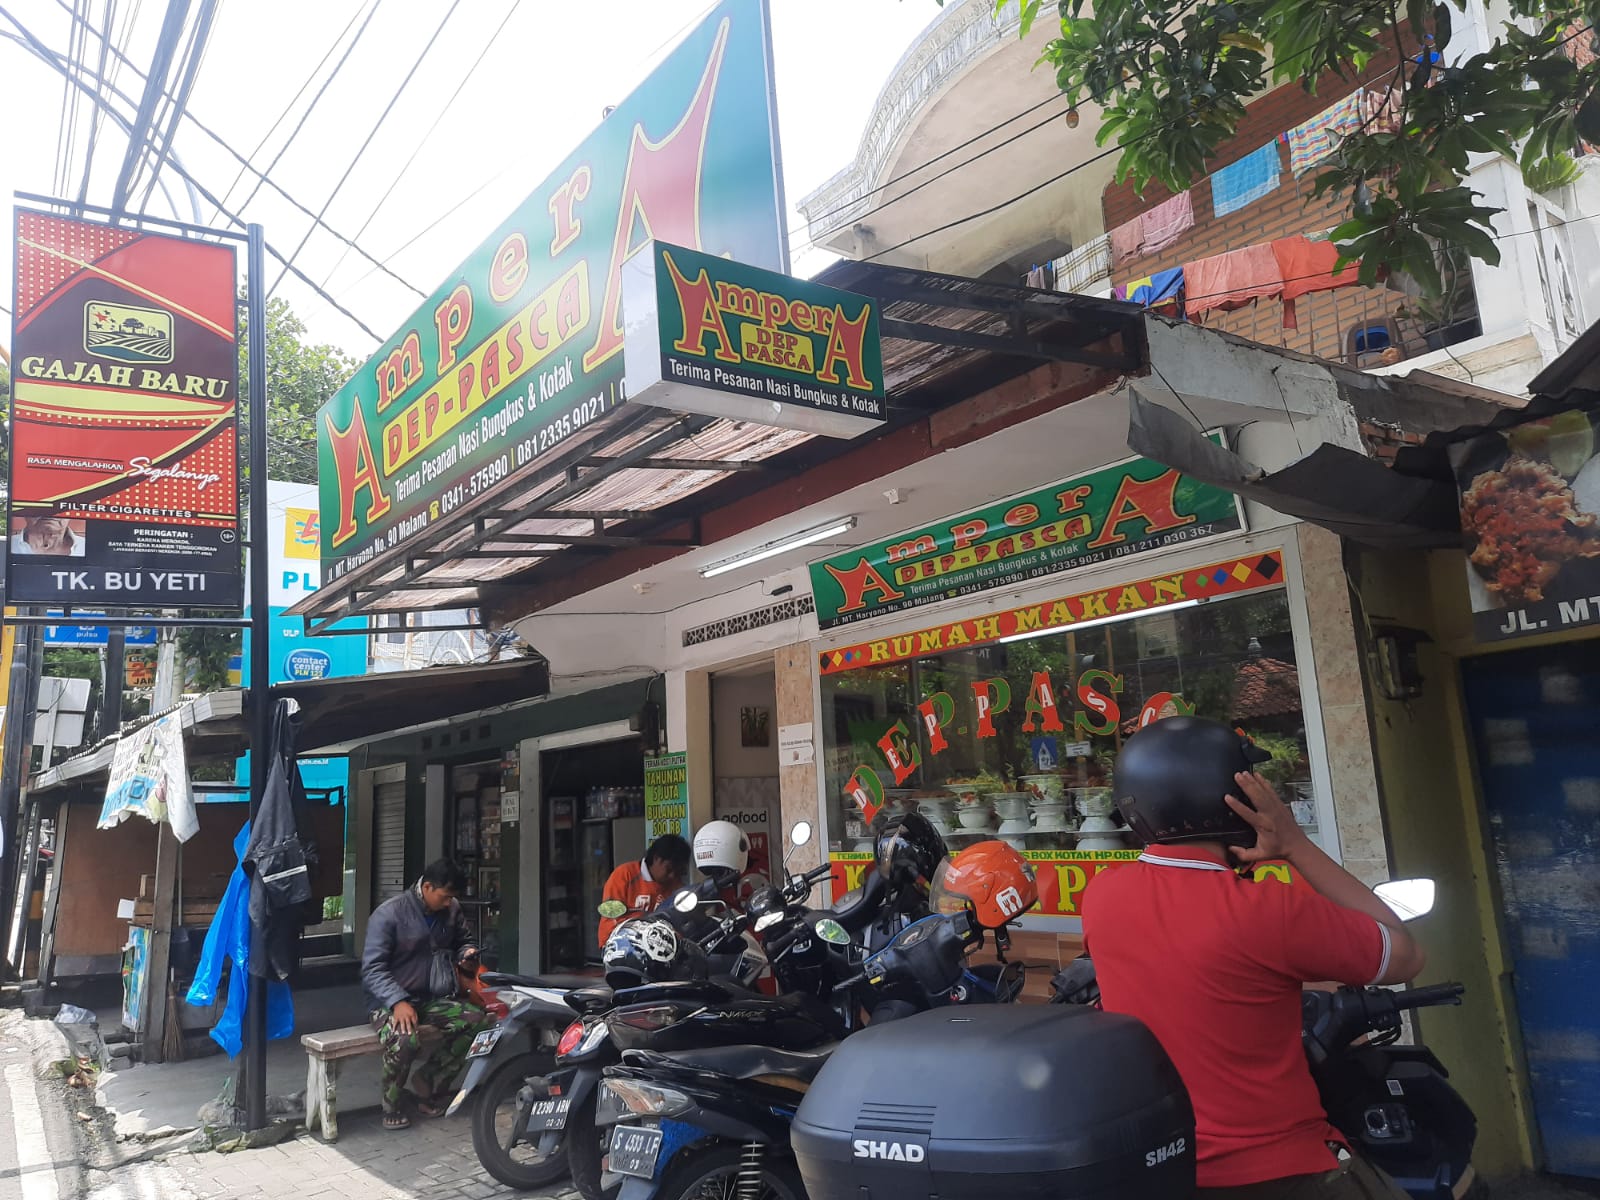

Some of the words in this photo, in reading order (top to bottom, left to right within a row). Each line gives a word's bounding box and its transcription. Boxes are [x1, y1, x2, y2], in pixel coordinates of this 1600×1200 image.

[663, 250, 873, 391] AmperA
[756, 328, 798, 352] DEP
[387, 272, 580, 467] DEP-PASCA
[746, 344, 811, 371] PASCA
[21, 356, 134, 386] GAJAH
[138, 369, 229, 398] BARU
[669, 358, 711, 381] Terima
[714, 369, 763, 392] Pesanan
[766, 377, 791, 397] Nasi
[794, 383, 838, 407] Bungkus
[841, 394, 849, 408] &
[852, 395, 880, 414] Kotak
[395, 472, 422, 504] Terima
[422, 445, 457, 488] Pesanan
[458, 428, 480, 461] Nasi
[482, 400, 525, 444] Bungkus
[527, 383, 537, 411] &
[539, 355, 574, 402] Kotak
[27, 457, 52, 466] RASA
[53, 458, 124, 471] MENGALAHKAN
[127, 457, 221, 490] Segalanya
[60, 502, 106, 513] FILTER
[109, 506, 192, 518] CIGARETTES
[134, 529, 188, 538] PERINGATAN
[375, 536, 386, 554] No.
[388, 527, 397, 547] 90
[398, 511, 427, 539] Malang
[824, 467, 1196, 613] AmperA
[901, 518, 1085, 583] DEP-PASCA
[52, 572, 95, 590] TK.
[105, 572, 141, 591] BU
[153, 572, 206, 592] YETI
[282, 571, 318, 591] PL
[842, 615, 855, 625] MT.
[856, 608, 886, 622] Haryono
[888, 604, 901, 612] No.
[903, 600, 913, 609] 90
[914, 592, 945, 606] Malang
[1079, 551, 1105, 568] 9021
[1116, 544, 1136, 557] 081
[1139, 538, 1160, 551] 211
[1164, 531, 1187, 545] 030
[1190, 524, 1213, 537] 367
[910, 581, 937, 595] Terima
[939, 573, 974, 589] Pesanan
[976, 566, 996, 579] Nasi
[998, 555, 1037, 573] Bungkus
[1040, 551, 1048, 561] &
[1050, 544, 1079, 559] Kotak
[869, 615, 1002, 663] RUMAH
[1015, 575, 1188, 629] MAKAN
[1500, 609, 1548, 635] JL.
[292, 657, 328, 665] contact
[294, 663, 325, 671] center
[646, 768, 685, 785] TAHUNAN
[660, 785, 679, 800] JUTA
[647, 803, 686, 820] BULANAN
[670, 820, 681, 834] RB
[1032, 851, 1053, 860] BOX
[1055, 850, 1091, 860] KOTAK
[615, 1132, 623, 1150] S
[854, 1139, 925, 1163] SHAD
[1145, 1138, 1187, 1168] SH42
